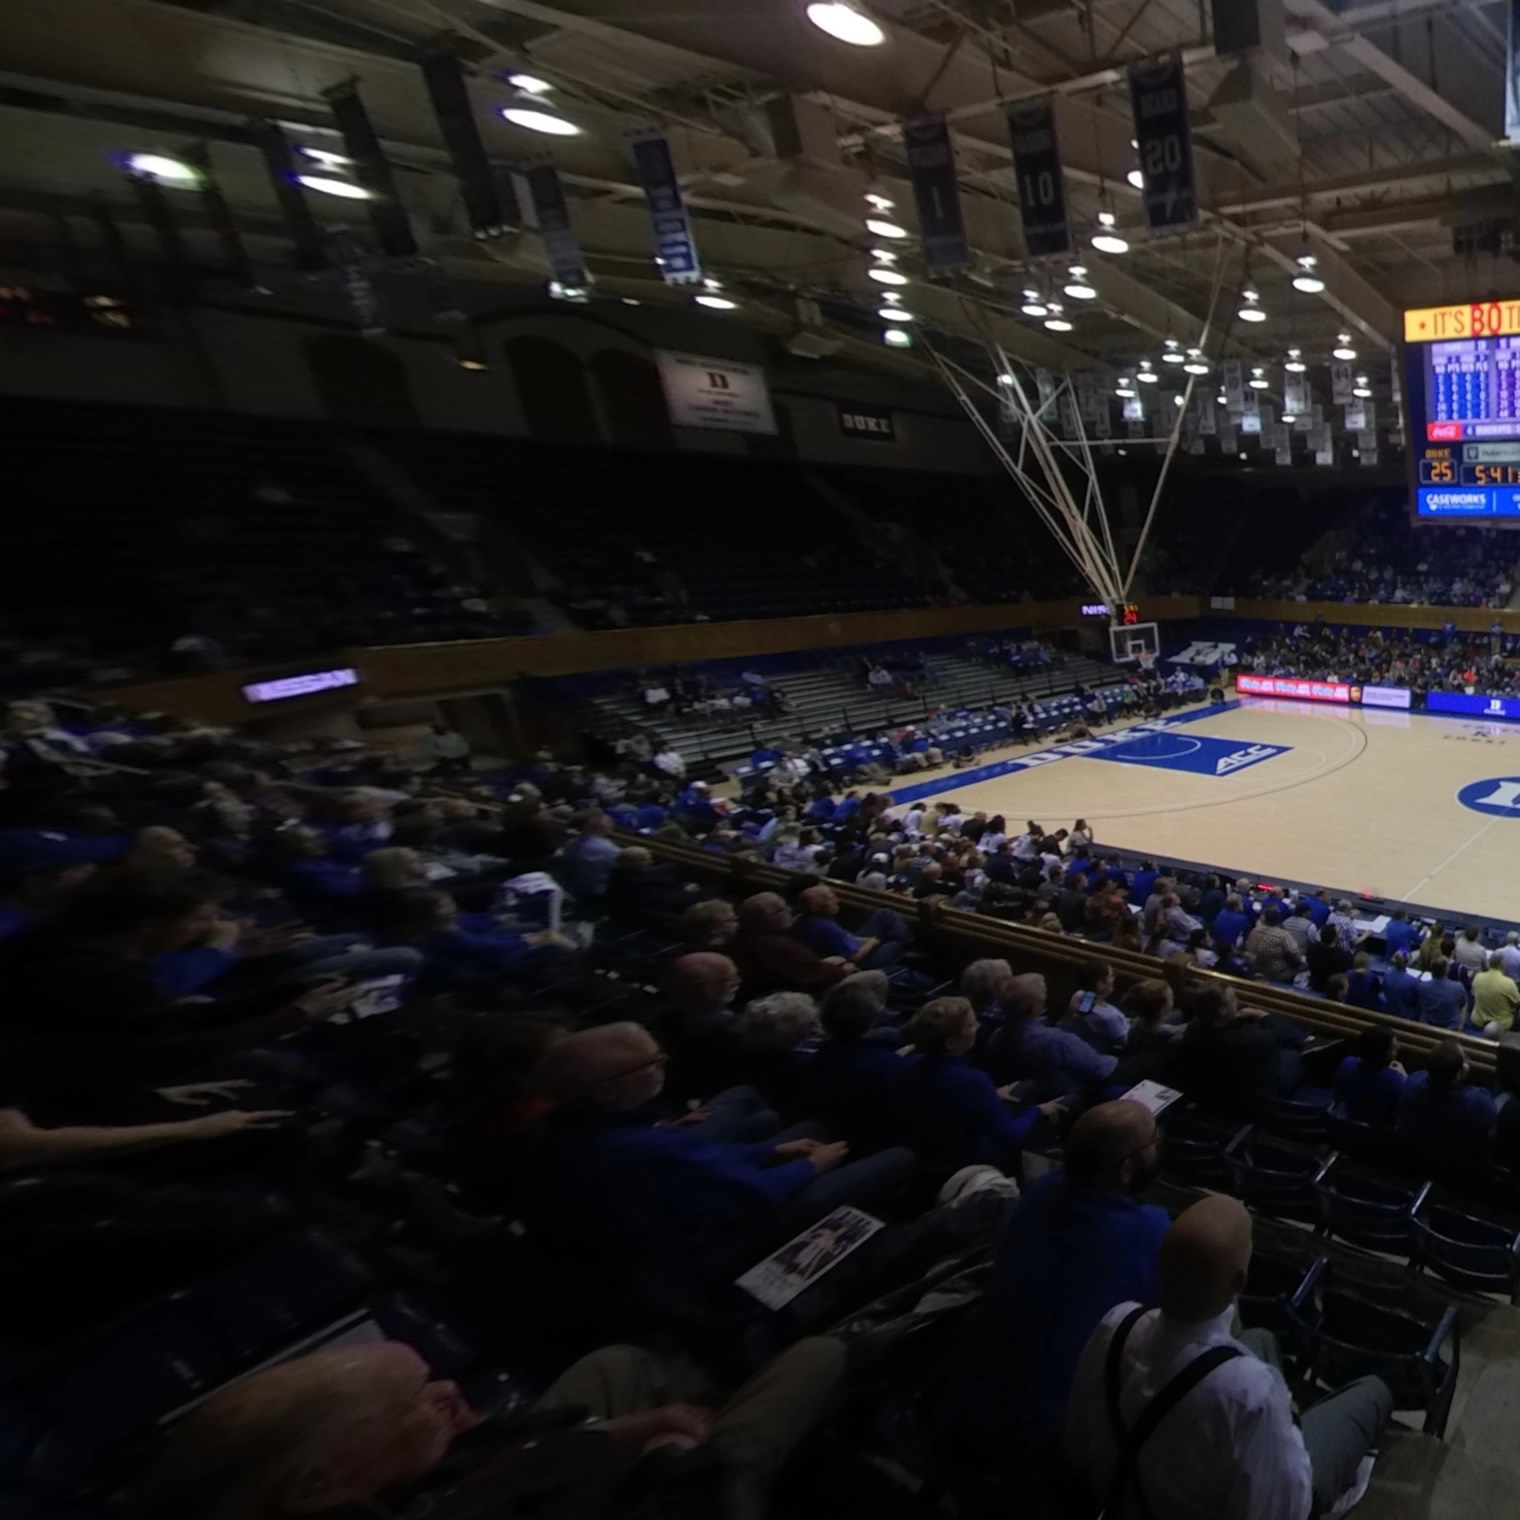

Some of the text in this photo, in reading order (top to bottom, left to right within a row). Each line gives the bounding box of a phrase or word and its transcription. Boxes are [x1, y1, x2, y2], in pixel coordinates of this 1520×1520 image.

[1146, 133, 1182, 177] 20
[1023, 171, 1054, 207] 10
[1434, 310, 1465, 336] IT'S
[1470, 302, 1502, 335] BO
[841, 412, 892, 434] DUKE
[1431, 460, 1453, 482] 25
[1426, 493, 1487, 506] CASEWORKS
[1215, 744, 1278, 775] ACC
